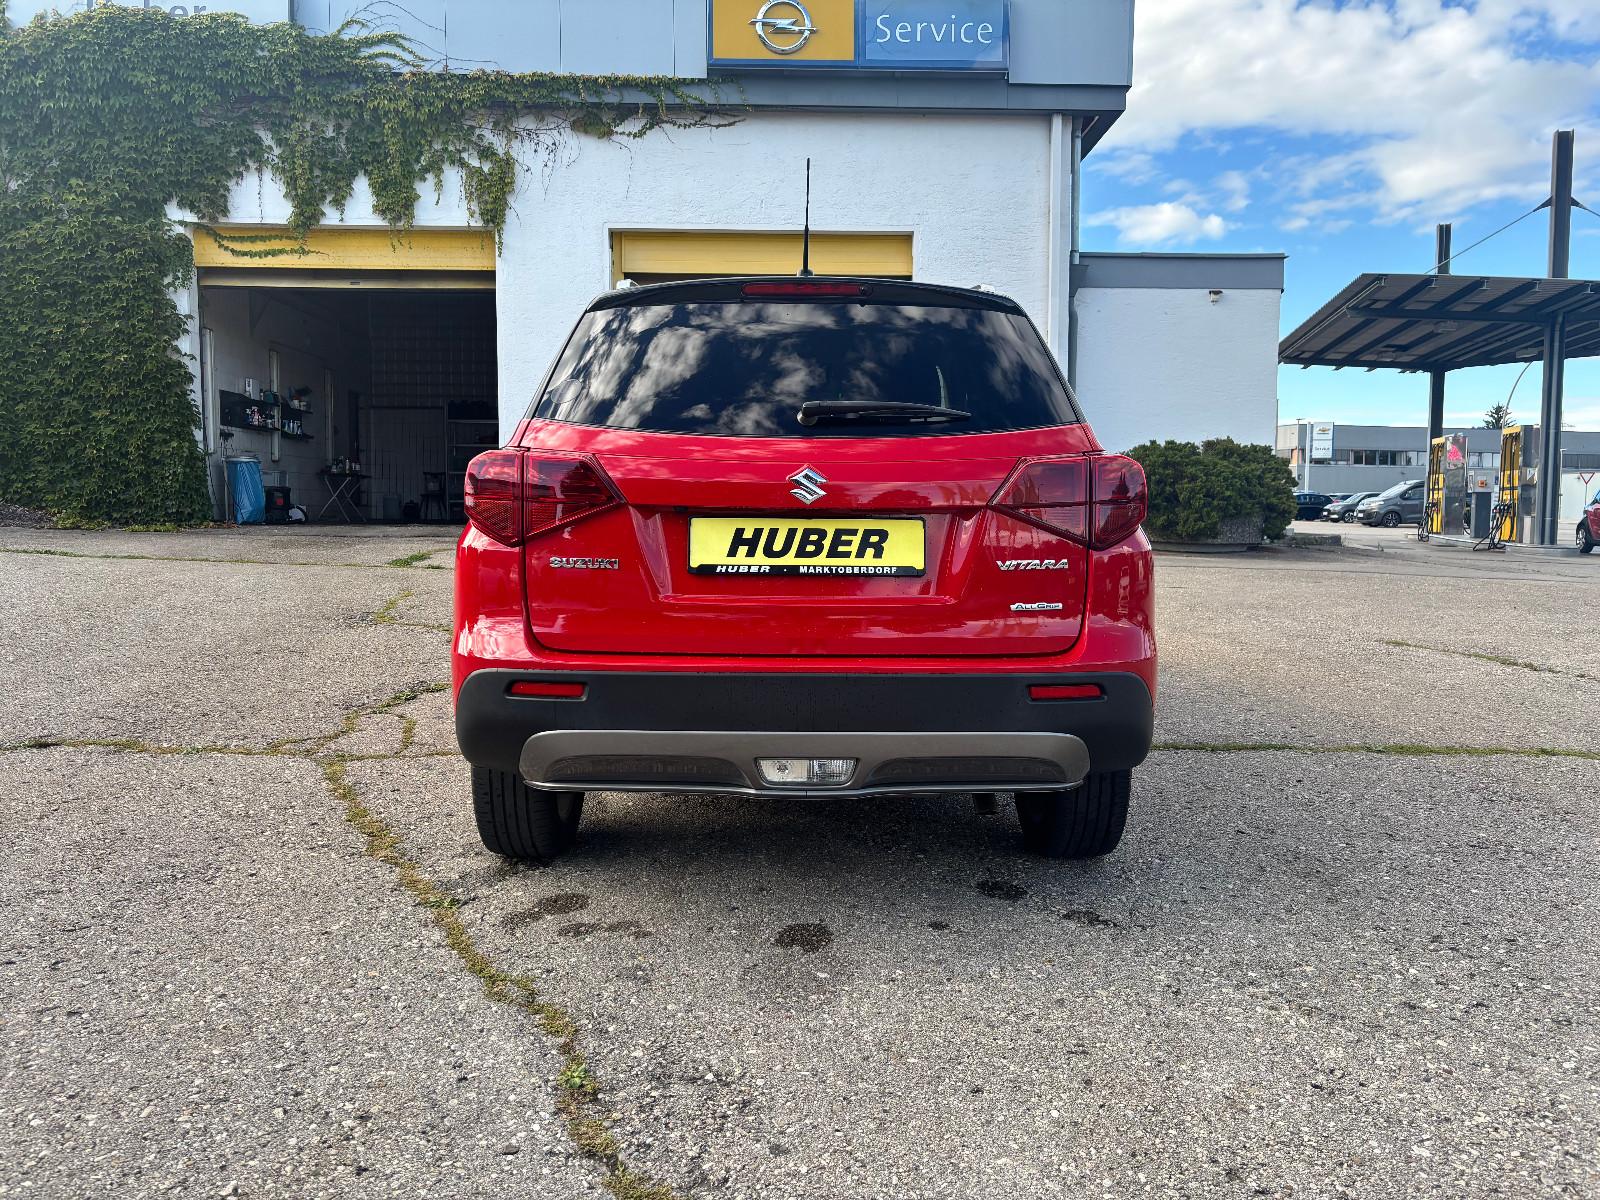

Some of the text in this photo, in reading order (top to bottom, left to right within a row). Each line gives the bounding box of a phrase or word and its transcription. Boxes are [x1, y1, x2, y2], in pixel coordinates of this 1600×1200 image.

[876, 14, 993, 44] Service
[726, 527, 889, 559] HUBER
[549, 556, 619, 570] SUZUKI
[715, 565, 898, 574] HUBER MARKTOBERDORF
[995, 558, 1069, 571] VITARA
